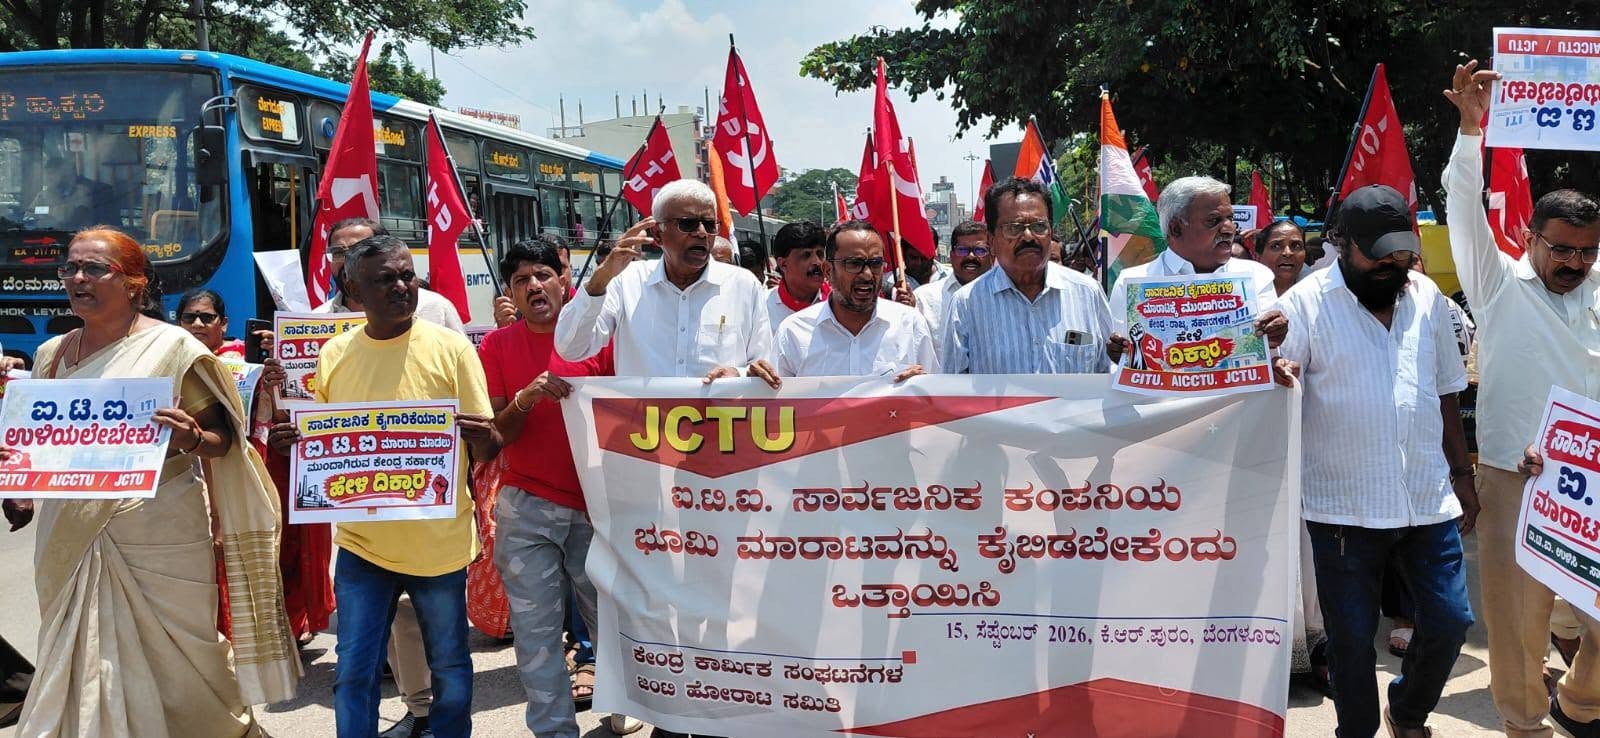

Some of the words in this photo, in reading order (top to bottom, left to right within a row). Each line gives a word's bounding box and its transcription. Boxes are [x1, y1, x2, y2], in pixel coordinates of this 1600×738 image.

[1508, 40, 1538, 52] JCTU
[128, 125, 177, 138] EXPRESS
[467, 274, 491, 286] BMTC
[33, 308, 77, 316] LEYLA
[1235, 306, 1250, 319] ITI
[284, 323, 336, 335] ಸಾರ್ವಜನಿಕ
[1176, 328, 1203, 343] ಹೇಳಿ
[285, 360, 318, 370] ಮುಂದಾ
[1130, 373, 1164, 386] CITU.
[1171, 373, 1218, 387] AICCTU.
[1224, 368, 1262, 384] JCTU.
[140, 399, 157, 412] ITI
[307, 413, 370, 431] ಸಾರ್ವಜನಿಕ
[376, 411, 446, 431] ಕೈಗಾರಿಕೆಯಾದ
[629, 406, 796, 454] JCTU
[5, 422, 163, 447] ಉಳಿಯಲೇಬೇಕು!
[1550, 428, 1600, 465] ಸಾರ್ವ
[307, 458, 370, 472] ಮುಂದಾಗಿರುವ
[374, 456, 402, 469] ಕೇಂದ್ರ
[48, 474, 96, 487] AICCTU
[114, 473, 146, 487] JCTU
[329, 475, 368, 497] ಹೇಳಿ
[792, 479, 983, 513] ಸಾರ್ವಜನಿಕ
[1004, 477, 1182, 512] ಕಂಪನಿಯ
[634, 522, 720, 557] ಭೂಮಿ
[736, 527, 959, 572] ಮಾರಾಟವನ್ನು
[978, 526, 1238, 574] ಕೈಬಿಡಬೇಕೆಂದು
[831, 581, 1001, 619] ಒತ್ತಾಯಿಸಿ
[946, 622, 969, 640] 15,
[1048, 625, 1093, 645] 2026,
[1203, 623, 1281, 645] ಬೆಂಗಳೂರು
[633, 646, 685, 674] ಕೇಂದ್ರ
[694, 655, 773, 678] ಕಾರ್ಮಿಕ
[783, 663, 904, 686] ಸಂಘಟನೆಗಳ
[637, 675, 676, 696] ಜಂಟಿ
[686, 680, 772, 706] ಹೋರಾಟ
[783, 693, 842, 713] ಸಮಿತಿ
